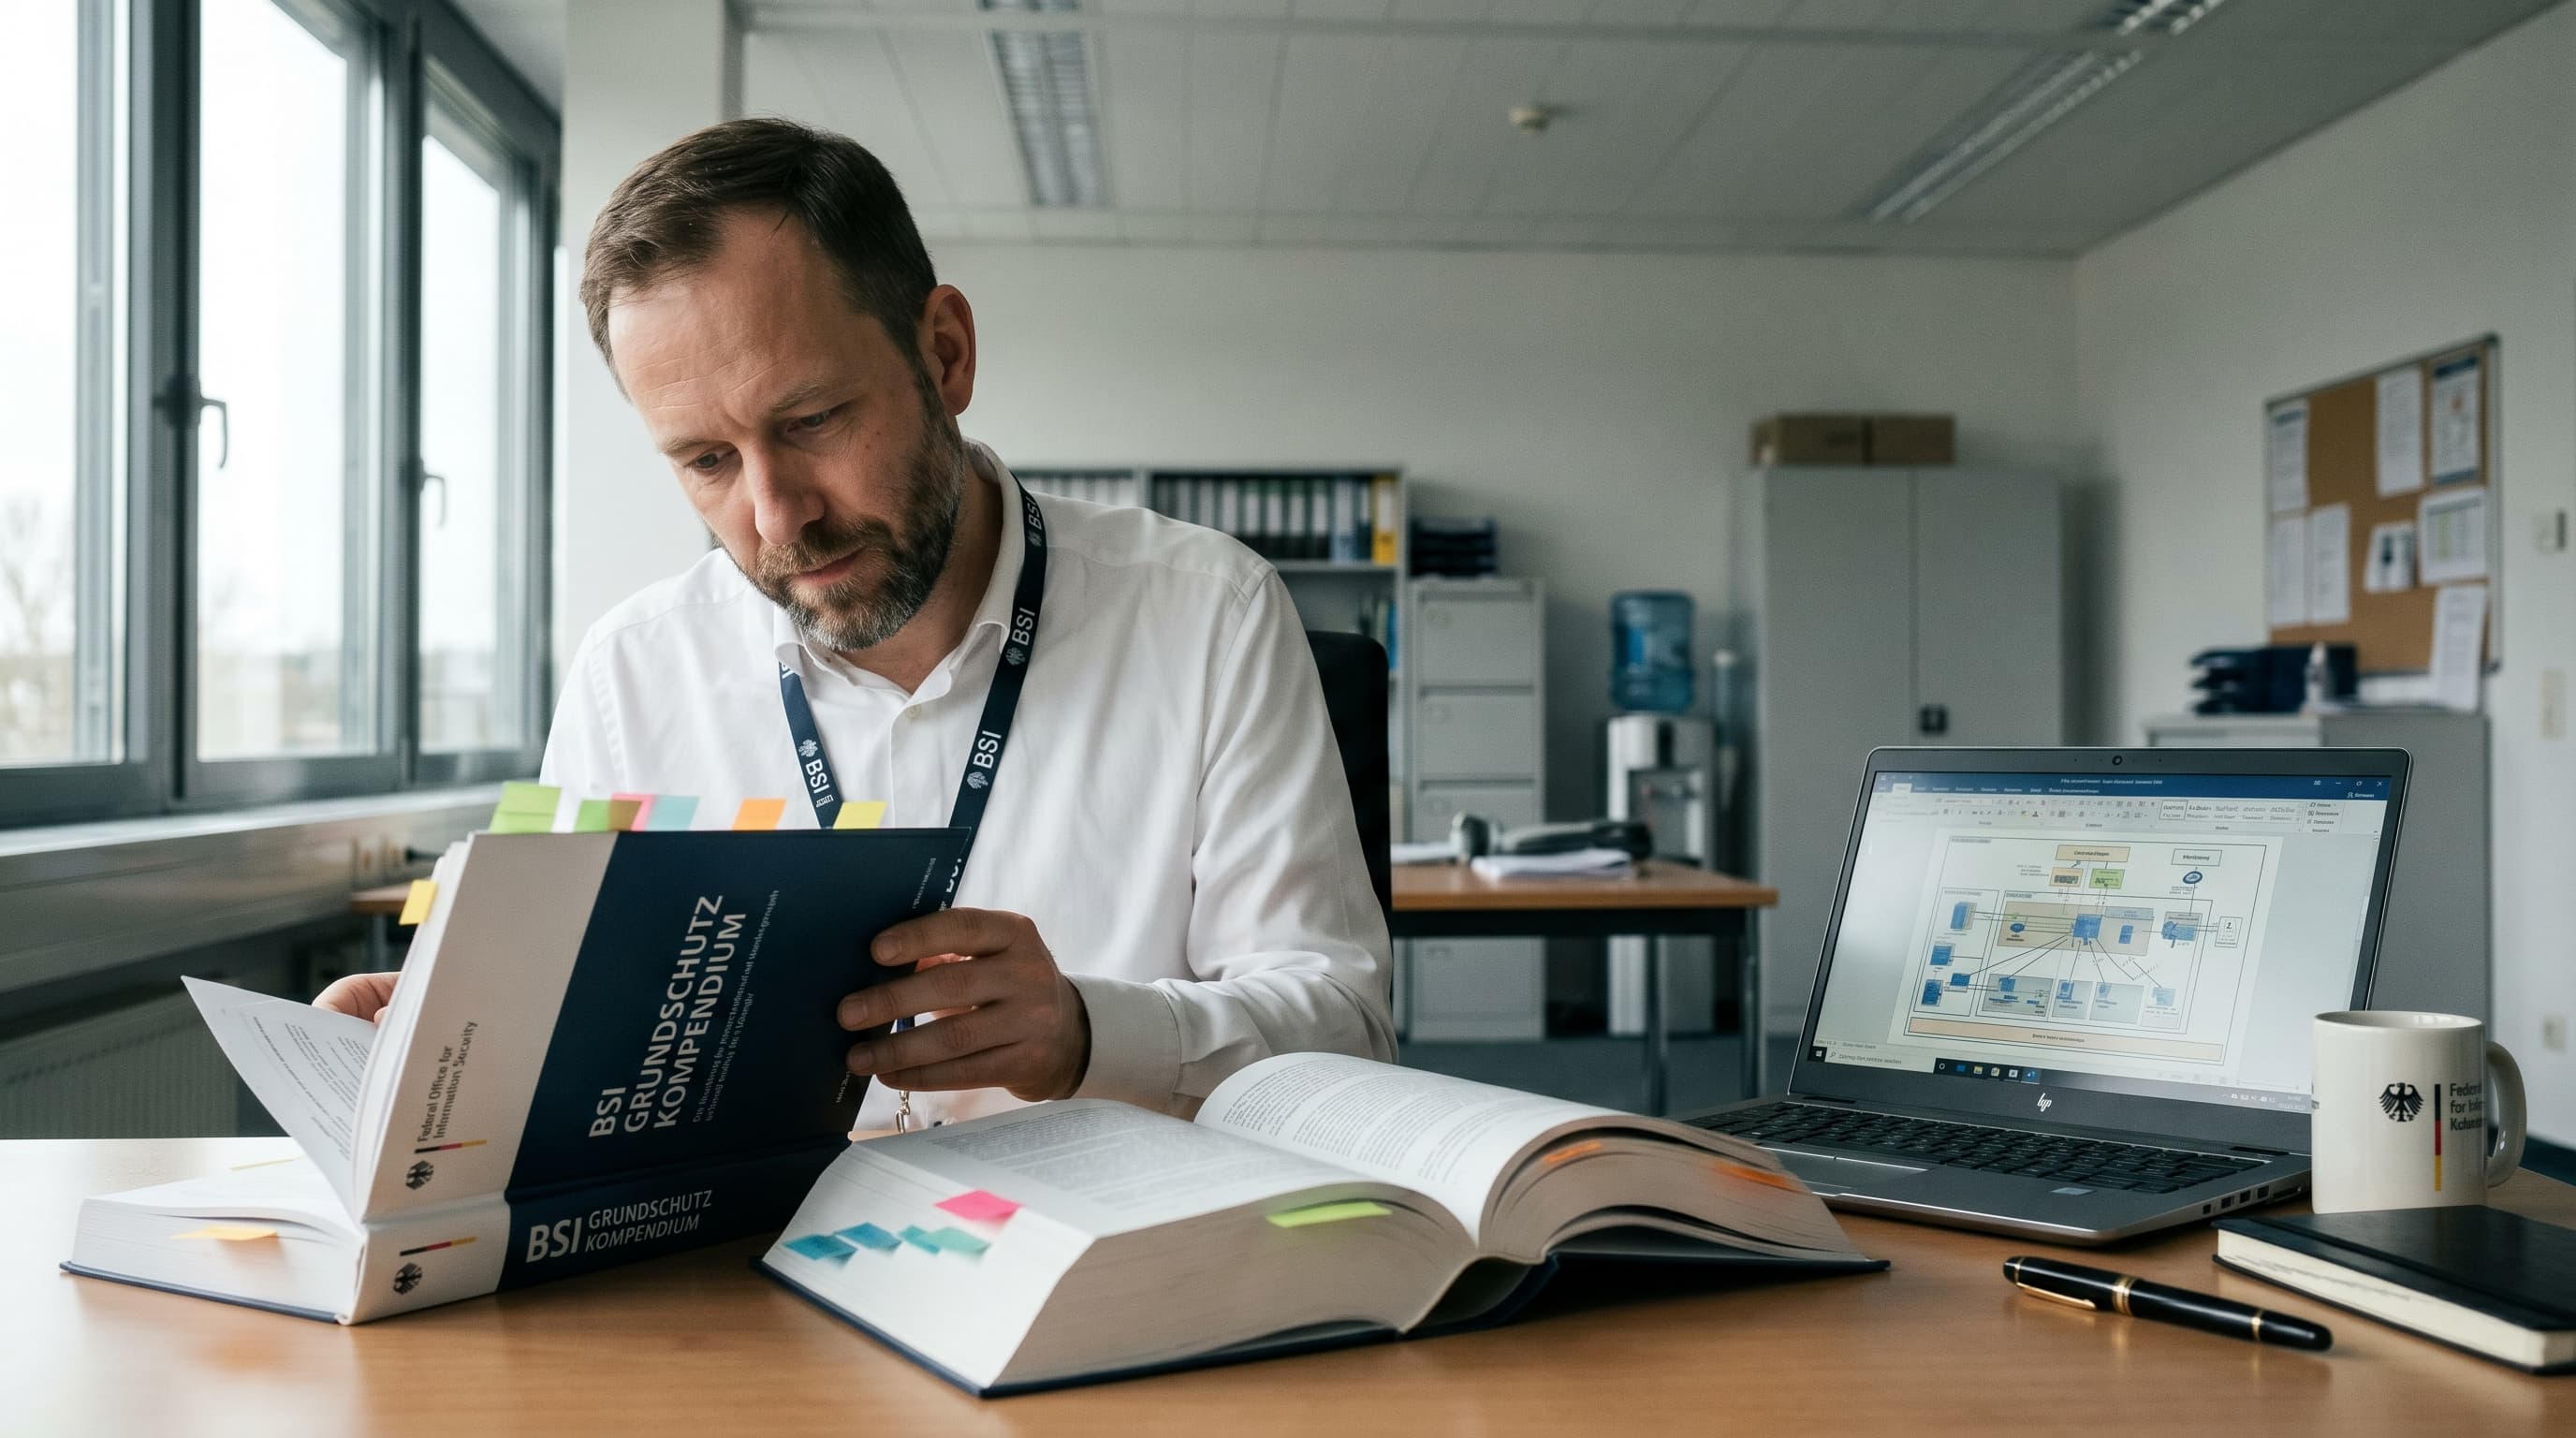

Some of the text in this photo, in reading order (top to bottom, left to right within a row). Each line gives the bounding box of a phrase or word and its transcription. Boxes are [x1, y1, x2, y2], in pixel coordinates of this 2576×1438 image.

[1026, 496, 1043, 531] BSI
[1012, 607, 1036, 646] BSI
[973, 730, 1002, 769] BSI
[805, 758, 830, 794] BSI
[624, 895, 723, 1133] GRUNDSCHUTZ
[654, 913, 747, 1128] KOMPENDIUM
[588, 1087, 626, 1137] BSI
[2450, 1099, 2466, 1113] for
[588, 1190, 712, 1229] GRUNDSCHUTZ
[525, 1217, 582, 1263] BSI
[585, 1213, 700, 1253] KOMPENDIUM
